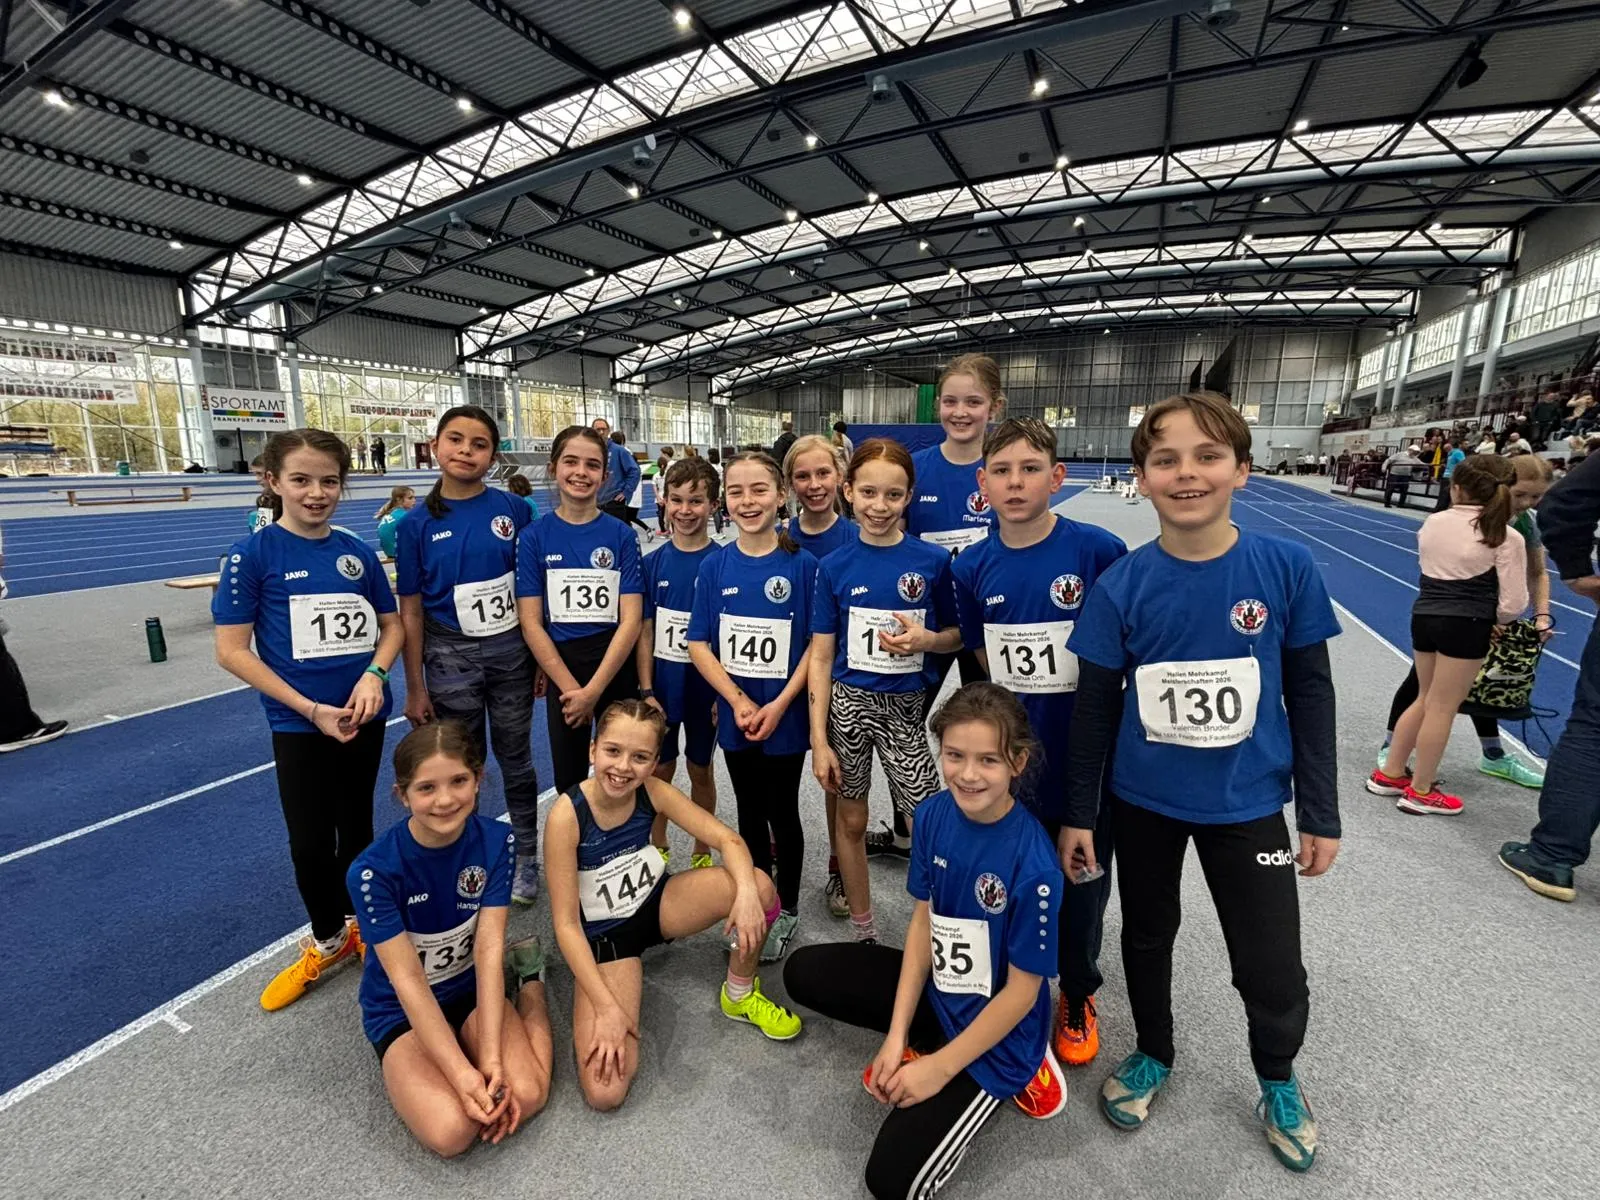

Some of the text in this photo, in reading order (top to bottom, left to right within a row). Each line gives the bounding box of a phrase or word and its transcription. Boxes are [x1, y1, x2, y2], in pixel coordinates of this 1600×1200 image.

[211, 395, 286, 411] SPORTAMT
[920, 495, 938, 503] JAKO
[963, 514, 992, 524] Marlene
[432, 530, 452, 542] JAKO
[284, 570, 309, 581] JAKO
[471, 589, 515, 623] 134
[560, 585, 610, 609] 136
[310, 611, 368, 641] 132
[665, 625, 688, 651] 13
[727, 633, 777, 664] 140
[999, 643, 1057, 676] 131
[1188, 669, 1228, 677] Mehrkampf
[1215, 676, 1232, 684] 2026
[1159, 685, 1242, 726] 130
[1256, 849, 1292, 865] adid
[596, 861, 656, 913] 144
[407, 893, 429, 905] AKO
[932, 935, 973, 975] 35
